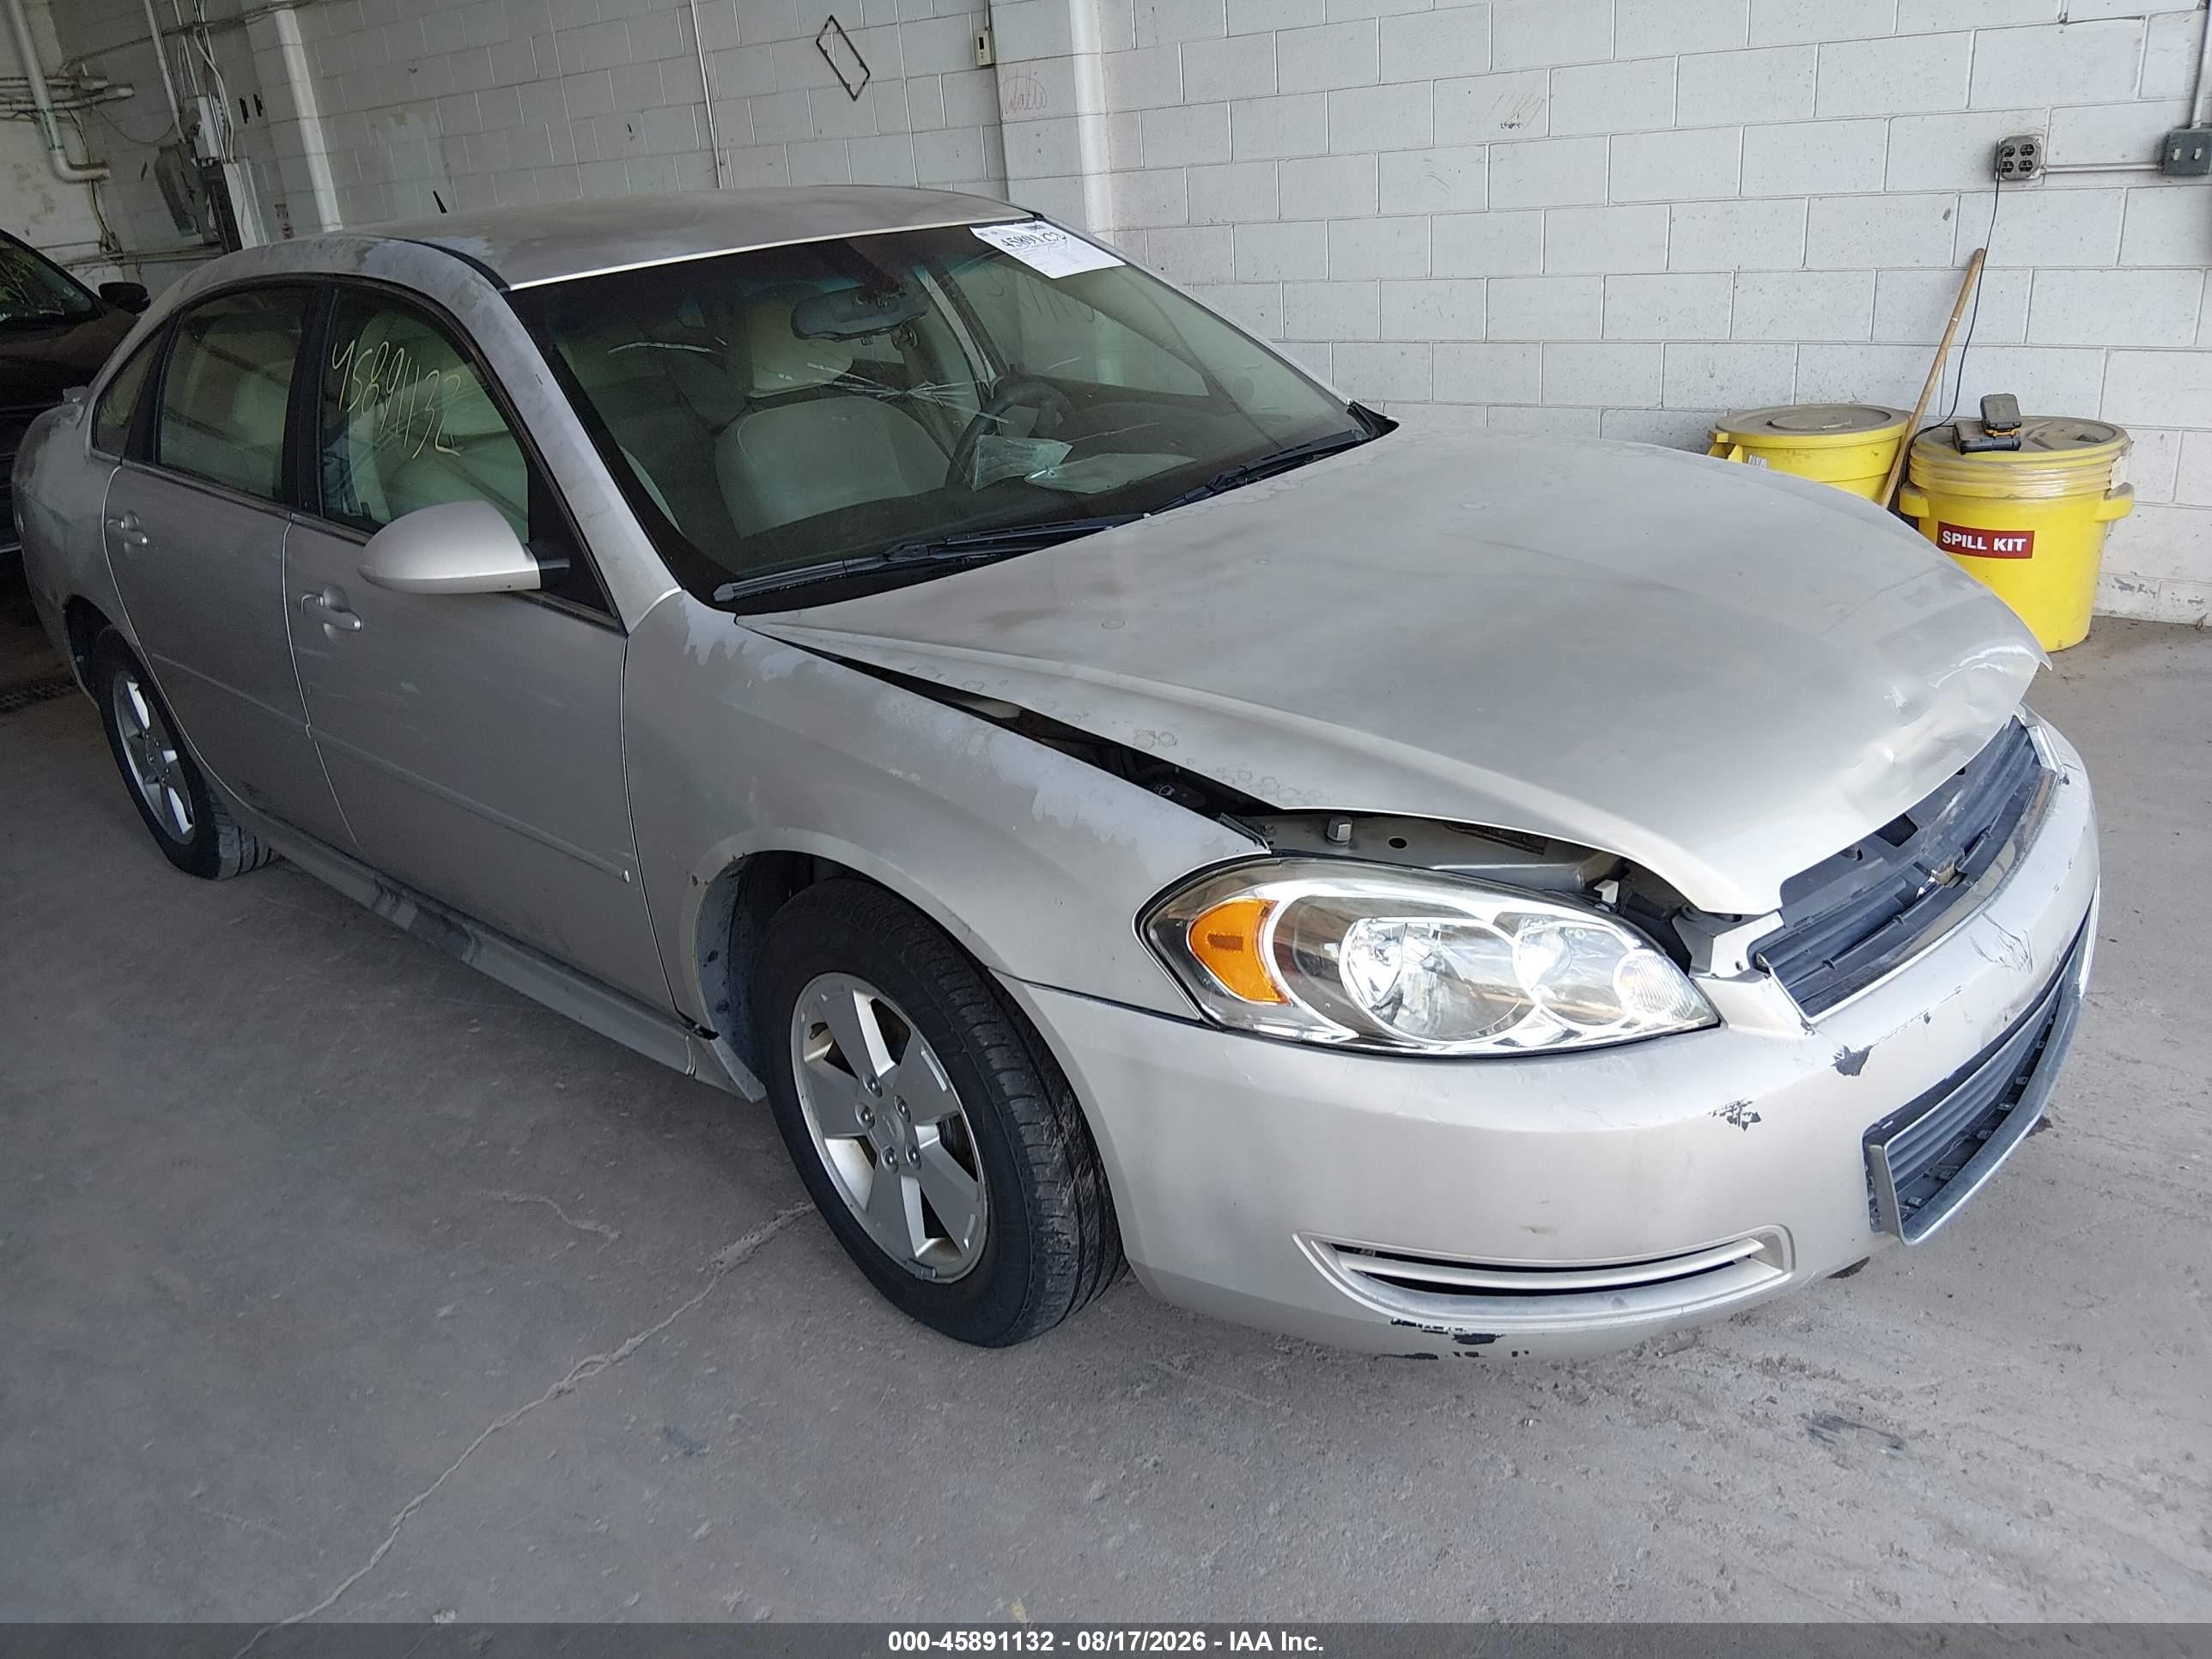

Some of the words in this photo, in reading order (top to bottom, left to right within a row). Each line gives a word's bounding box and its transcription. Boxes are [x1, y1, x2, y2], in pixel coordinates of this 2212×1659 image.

[331, 340, 461, 459] 45891132
[1942, 530, 1988, 550] SPILL
[1993, 538, 2027, 552] KIT
